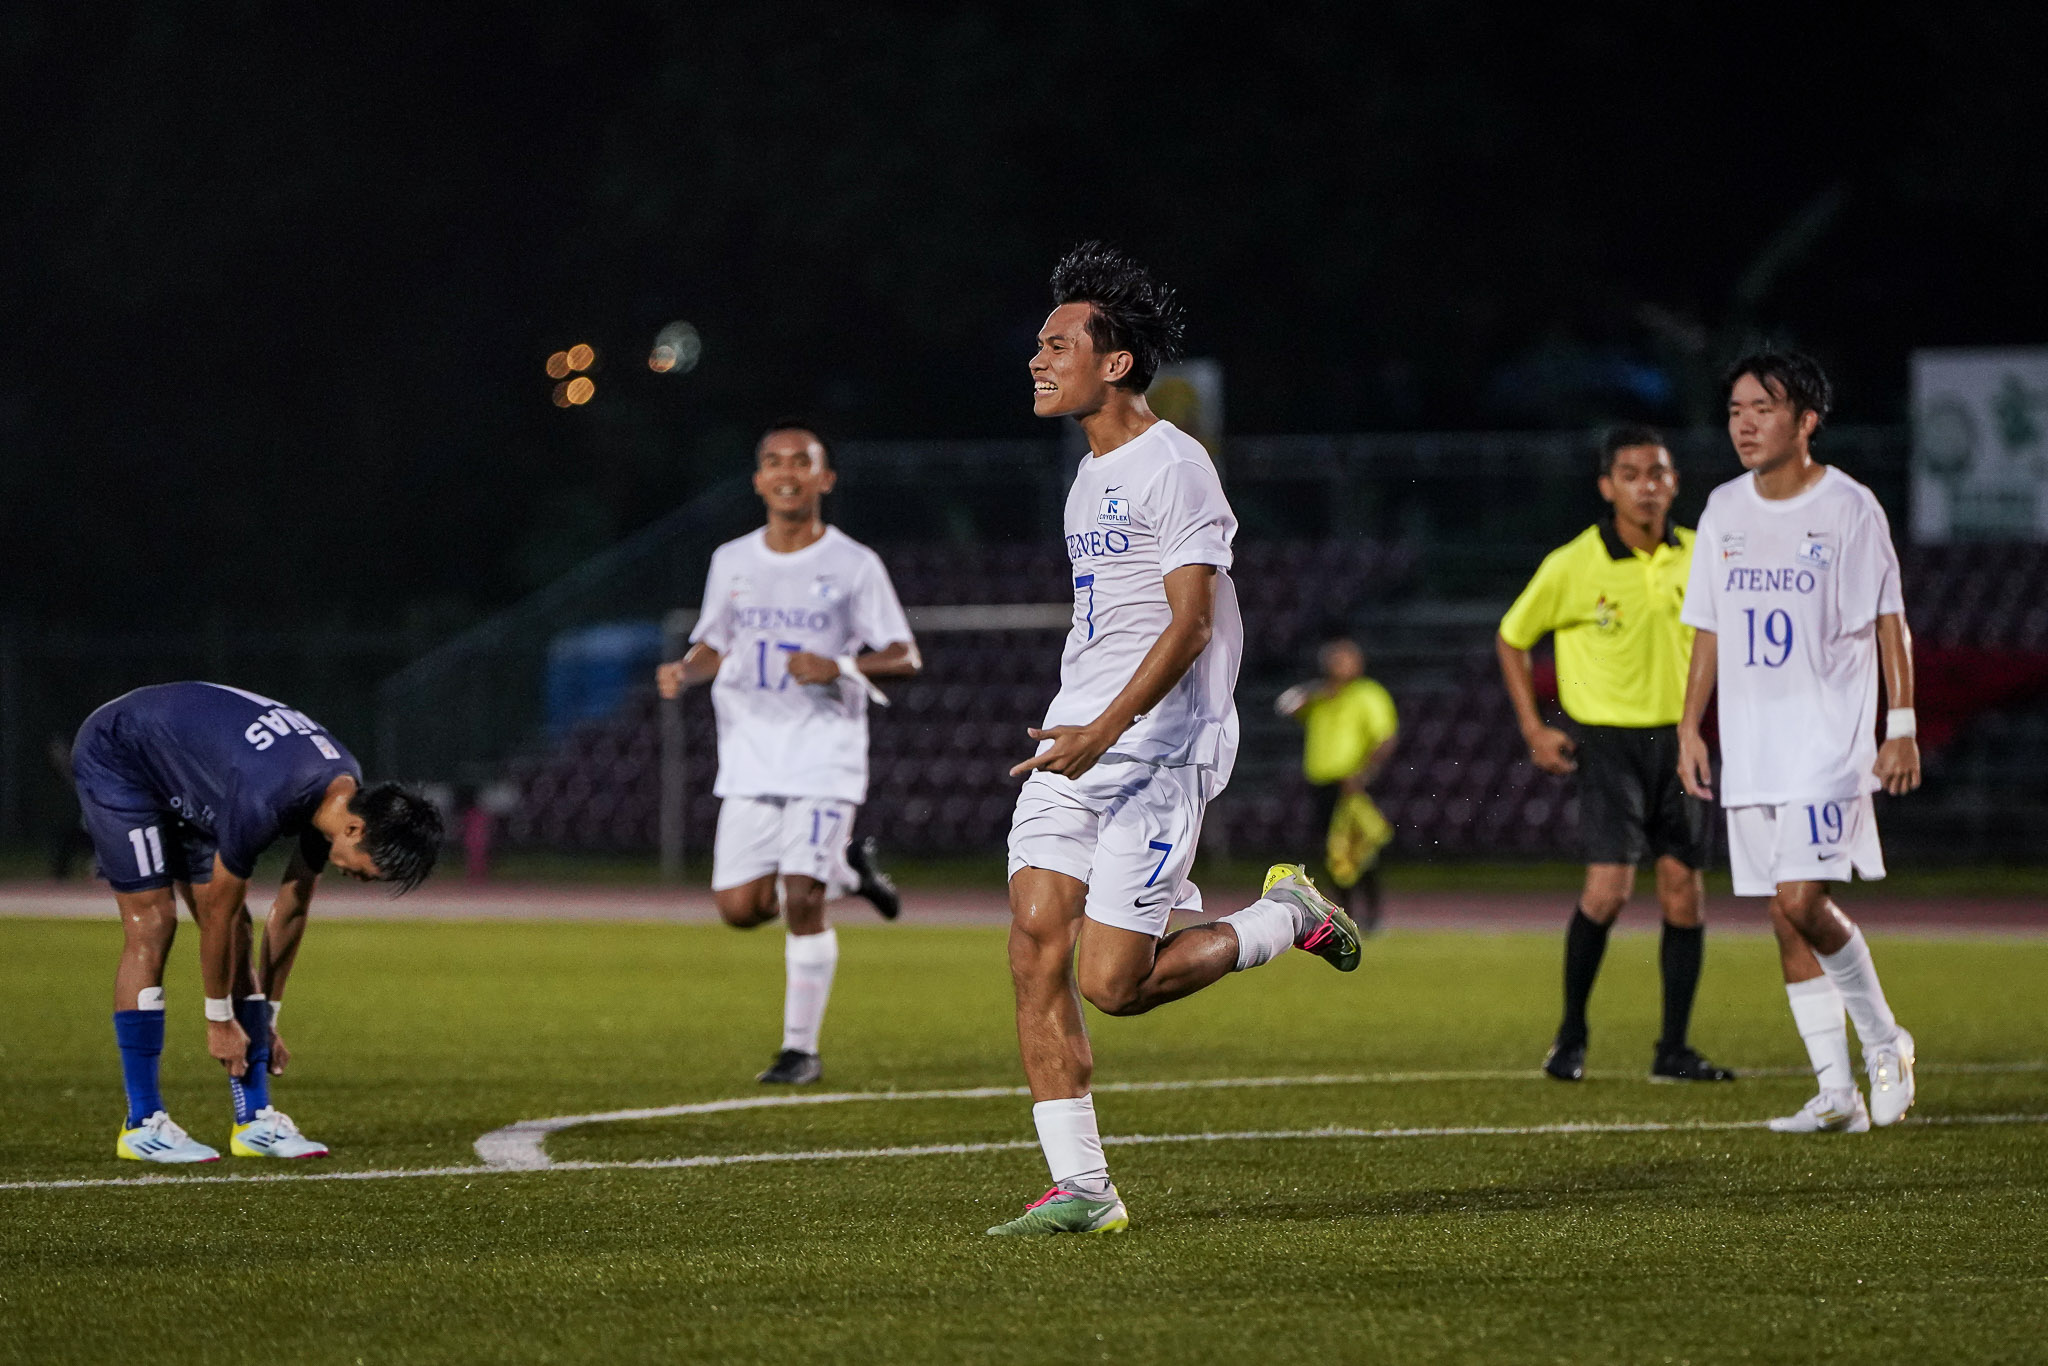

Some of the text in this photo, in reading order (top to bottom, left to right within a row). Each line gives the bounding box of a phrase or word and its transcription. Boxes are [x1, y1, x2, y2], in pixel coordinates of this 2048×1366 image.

[1075, 573, 1095, 642] 7
[1743, 607, 1794, 669] 19
[755, 640, 802, 691] 17
[810, 809, 841, 846] 17
[1803, 801, 1843, 845] 19
[128, 826, 165, 877] 11
[1144, 840, 1173, 888] 7
